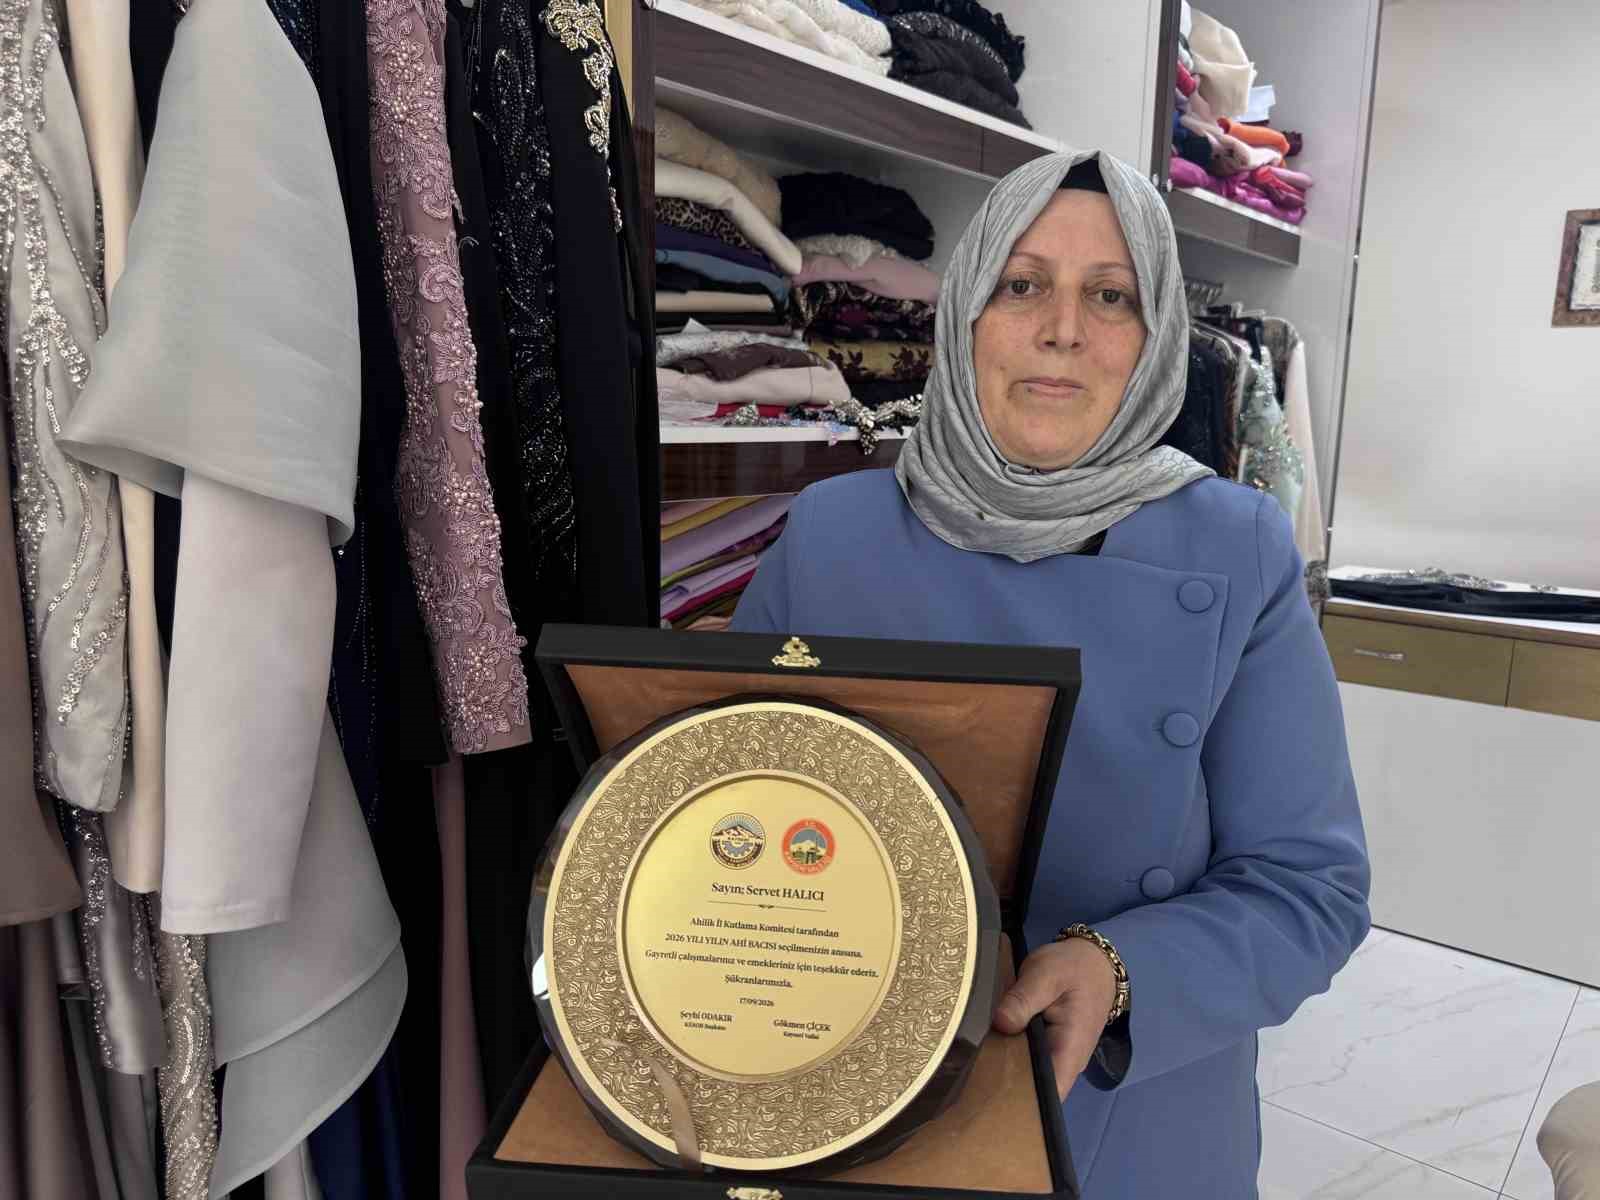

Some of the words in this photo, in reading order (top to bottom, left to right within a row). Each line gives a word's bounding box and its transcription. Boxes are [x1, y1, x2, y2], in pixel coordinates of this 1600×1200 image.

[746, 885, 780, 898] Servet
[782, 888, 825, 901] HALICI
[690, 918, 715, 927] Ahilik
[716, 918, 723, 928] İl
[759, 923, 796, 934] Komitesi
[796, 927, 839, 937] tarafından
[665, 933, 685, 942] 2026
[686, 935, 705, 944] YILI
[705, 937, 729, 945] YILIN
[731, 939, 748, 948] AHİ
[748, 941, 777, 950] BACISI
[778, 944, 830, 955] seçilmenizin
[645, 949, 678, 960] Gayretli
[737, 957, 746, 965] ve
[746, 959, 795, 970] emekleriniz
[796, 963, 812, 973] için
[813, 965, 849, 976] teşekkür
[850, 968, 879, 978] ederiz.
[724, 974, 792, 988] Şükranlarımızla.
[773, 1019, 805, 1029] Gökmen
[806, 1021, 832, 1032] ÇİÇEK
